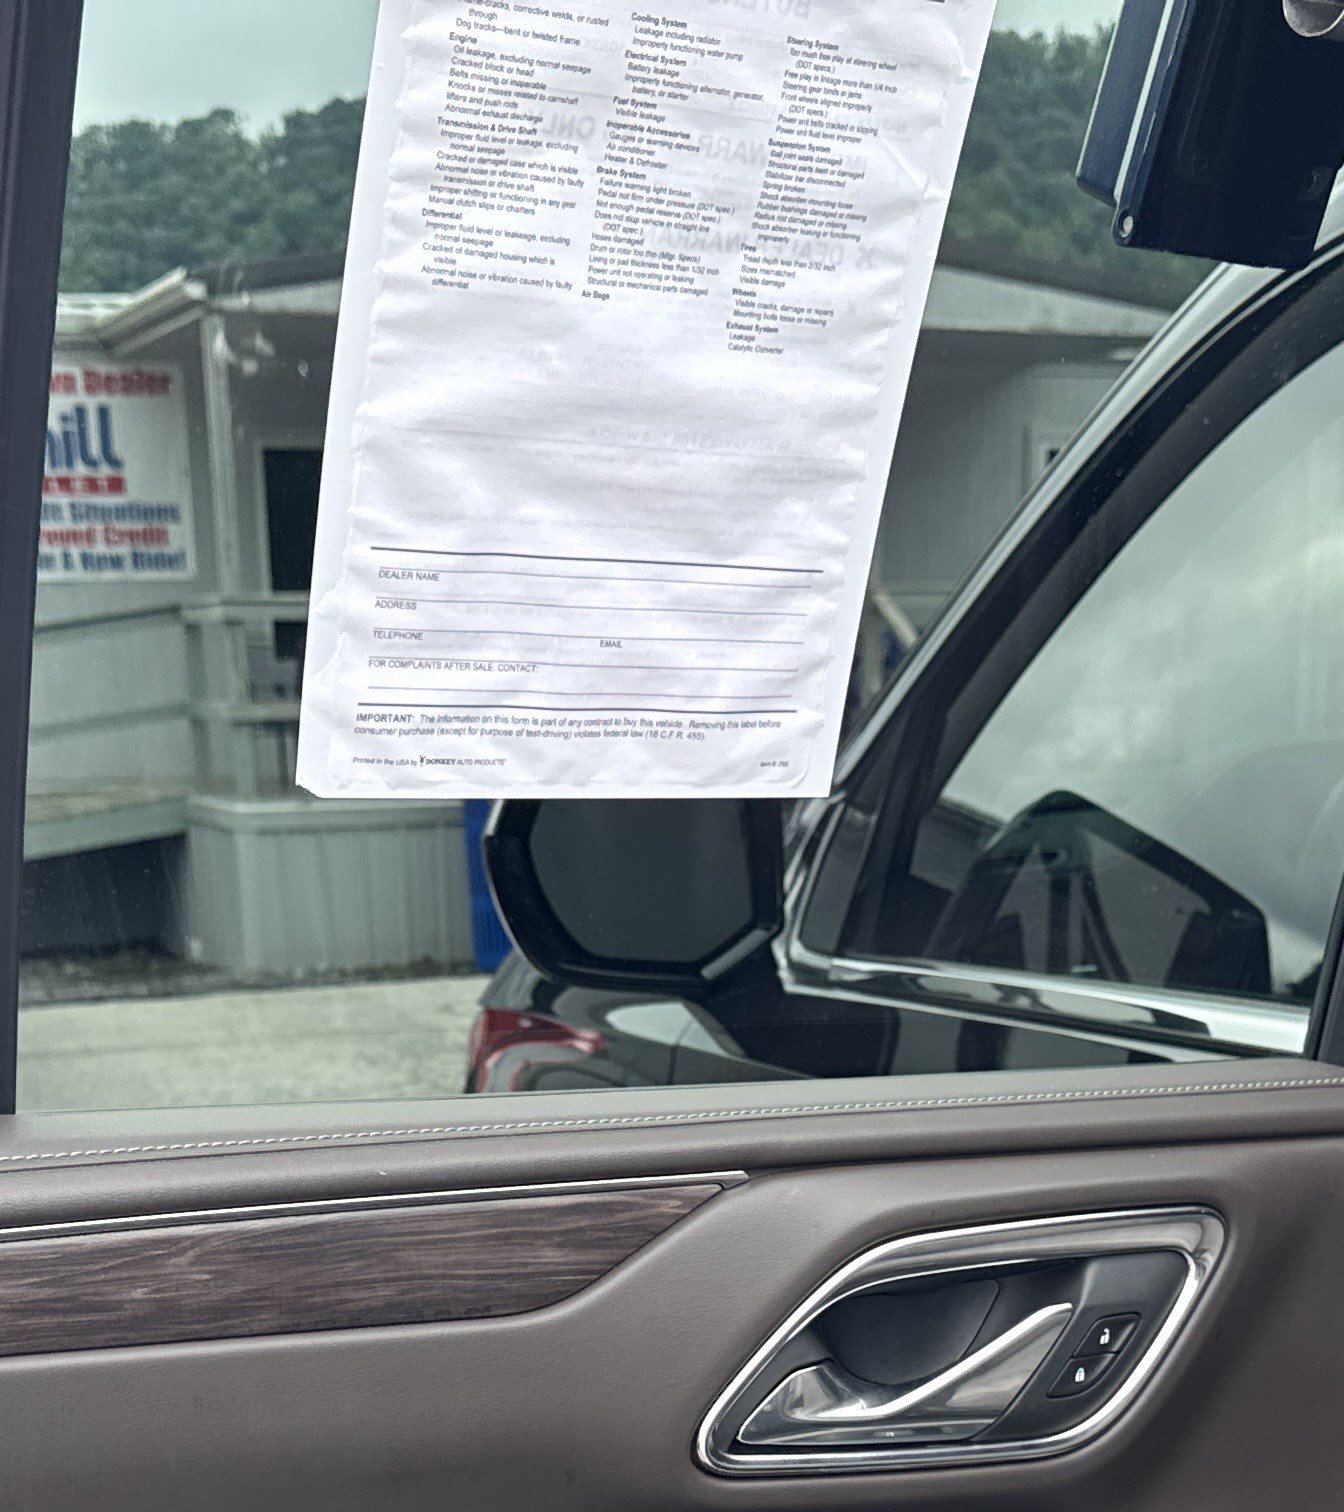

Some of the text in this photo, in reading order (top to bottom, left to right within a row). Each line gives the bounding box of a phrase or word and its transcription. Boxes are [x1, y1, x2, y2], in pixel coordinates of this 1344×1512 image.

[469, 9, 498, 21] through
[631, 12, 688, 29] Cooling System
[449, 33, 478, 45] Engine
[456, 18, 472, 29] Dog
[532, 30, 558, 41] twisted
[560, 35, 580, 45] frame
[635, 26, 720, 45] Leakage including radiator
[787, 36, 839, 52] Steering System
[451, 56, 483, 68] Cracked
[485, 62, 505, 72] block
[516, 66, 535, 76] head
[625, 50, 687, 67] Electrical System
[628, 62, 680, 78] Battery leakage
[449, 68, 469, 78] Belts
[471, 73, 500, 84] missing
[510, 77, 547, 91] inoperable
[613, 96, 657, 110] Fuel System
[438, 116, 489, 129] Transmission
[498, 123, 517, 132] Drive
[518, 125, 537, 134] Shaft
[606, 120, 690, 139] Inoperable Accessories
[768, 138, 831, 154] Suspension System
[596, 166, 646, 181] Brake System
[422, 208, 462, 219] Differential
[582, 290, 610, 301] Air Bags
[726, 321, 779, 334] Exhaust System
[82, 368, 170, 394] Dealer
[104, 526, 169, 546] Credit
[378, 570, 439, 581] DEALER NAME
[374, 600, 417, 610] ADDRESS
[373, 630, 423, 640] TELEPHONE
[599, 640, 622, 648] EMAIL
[367, 660, 386, 668] FOR
[387, 660, 442, 670] COMPLAINTS
[443, 662, 470, 671] AFTER
[420, 714, 435, 722] The
[437, 714, 480, 723] information
[494, 716, 508, 724] this
[511, 717, 529, 725] form
[540, 718, 556, 727] part
[556, 718, 566, 726] of
[582, 718, 613, 726] contract
[622, 719, 637, 728] buy
[639, 719, 653, 727] this
[688, 720, 726, 729] Removing
[726, 720, 739, 728] this
[740, 720, 757, 728] label
[758, 720, 781, 728] before
[398, 727, 435, 737] purchase
[436, 728, 465, 738] (except
[468, 728, 477, 736] for
[479, 730, 513, 738] purpose
[515, 729, 523, 737] of
[573, 729, 601, 737] violates
[602, 730, 628, 738] federal
[629, 730, 644, 738] law
